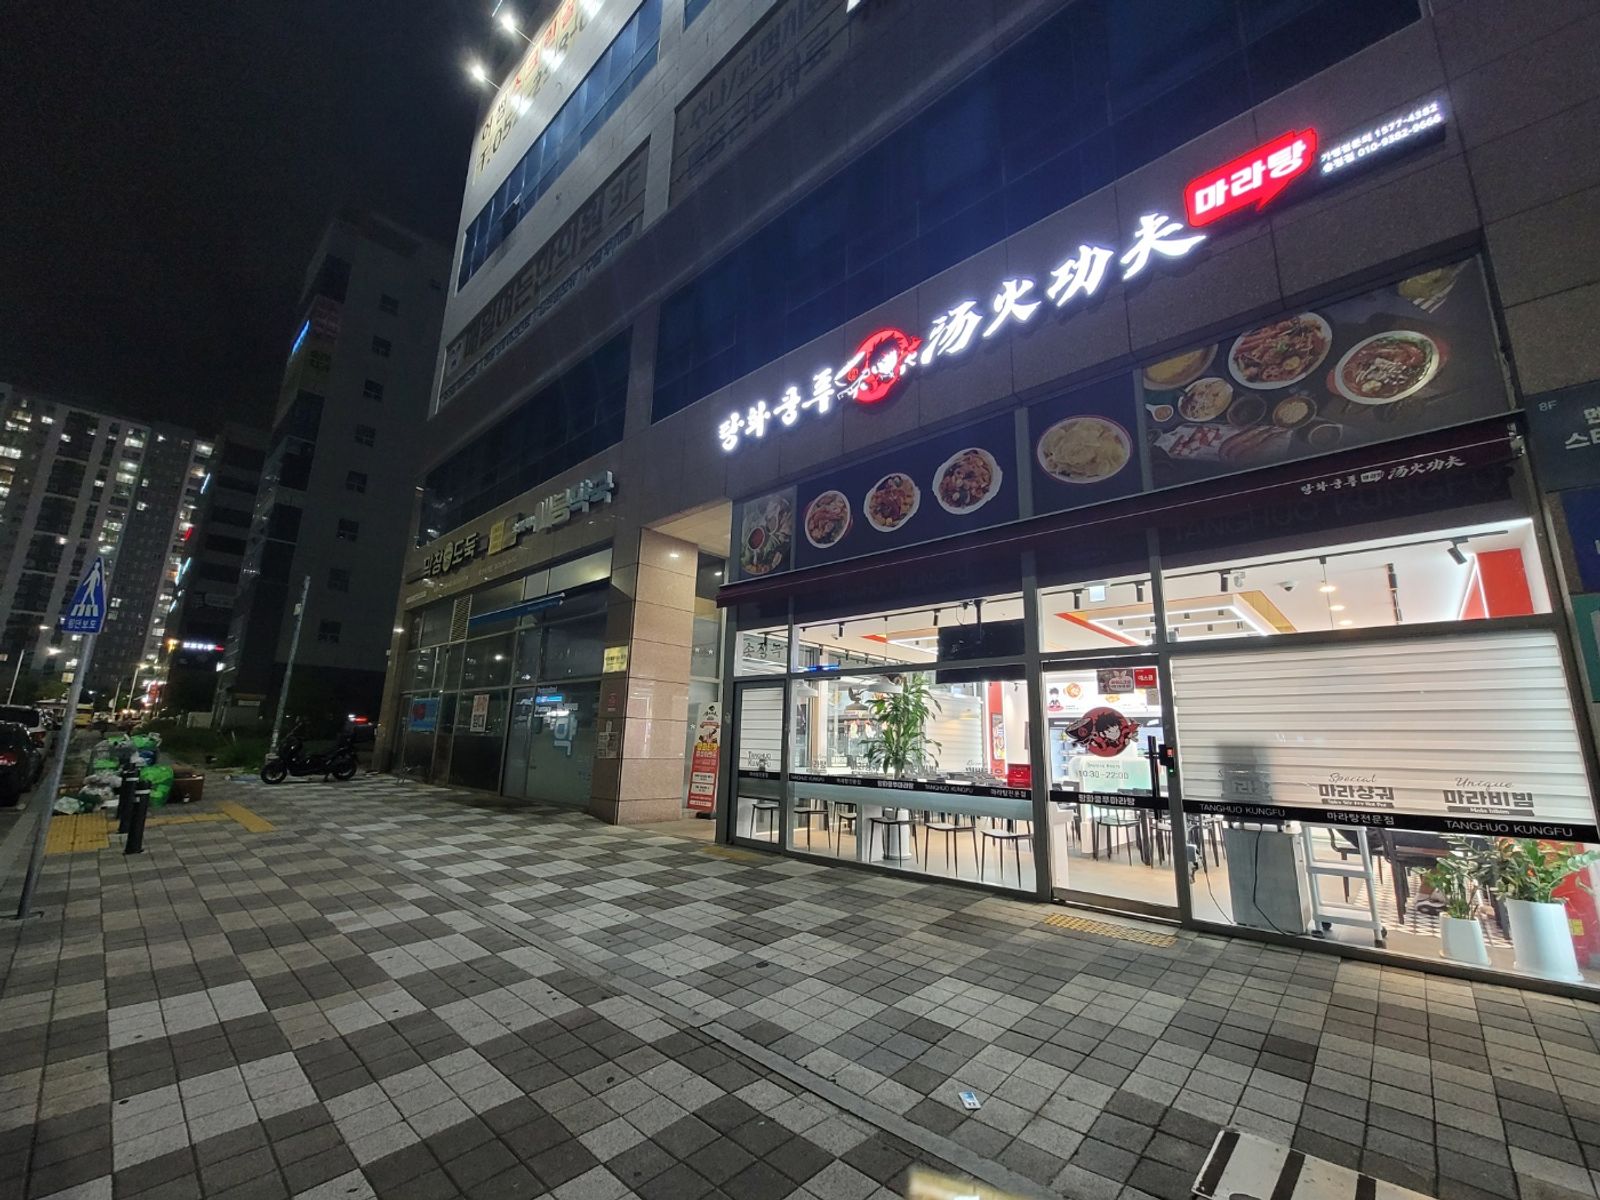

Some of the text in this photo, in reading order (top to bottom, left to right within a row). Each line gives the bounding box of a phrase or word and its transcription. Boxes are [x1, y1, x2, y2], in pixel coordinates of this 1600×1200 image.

[1194, 139, 1307, 215] 마라탕
[920, 212, 1207, 366] 汤火功夫
[1454, 777, 1514, 791] Unique
[1443, 789, 1535, 808] 마라비빔
[1200, 803, 1285, 817] TANGHUO KUNGFU
[1327, 811, 1395, 826] 마라탕전문점
[1444, 820, 1573, 837] TANGHUO KUNGFU
